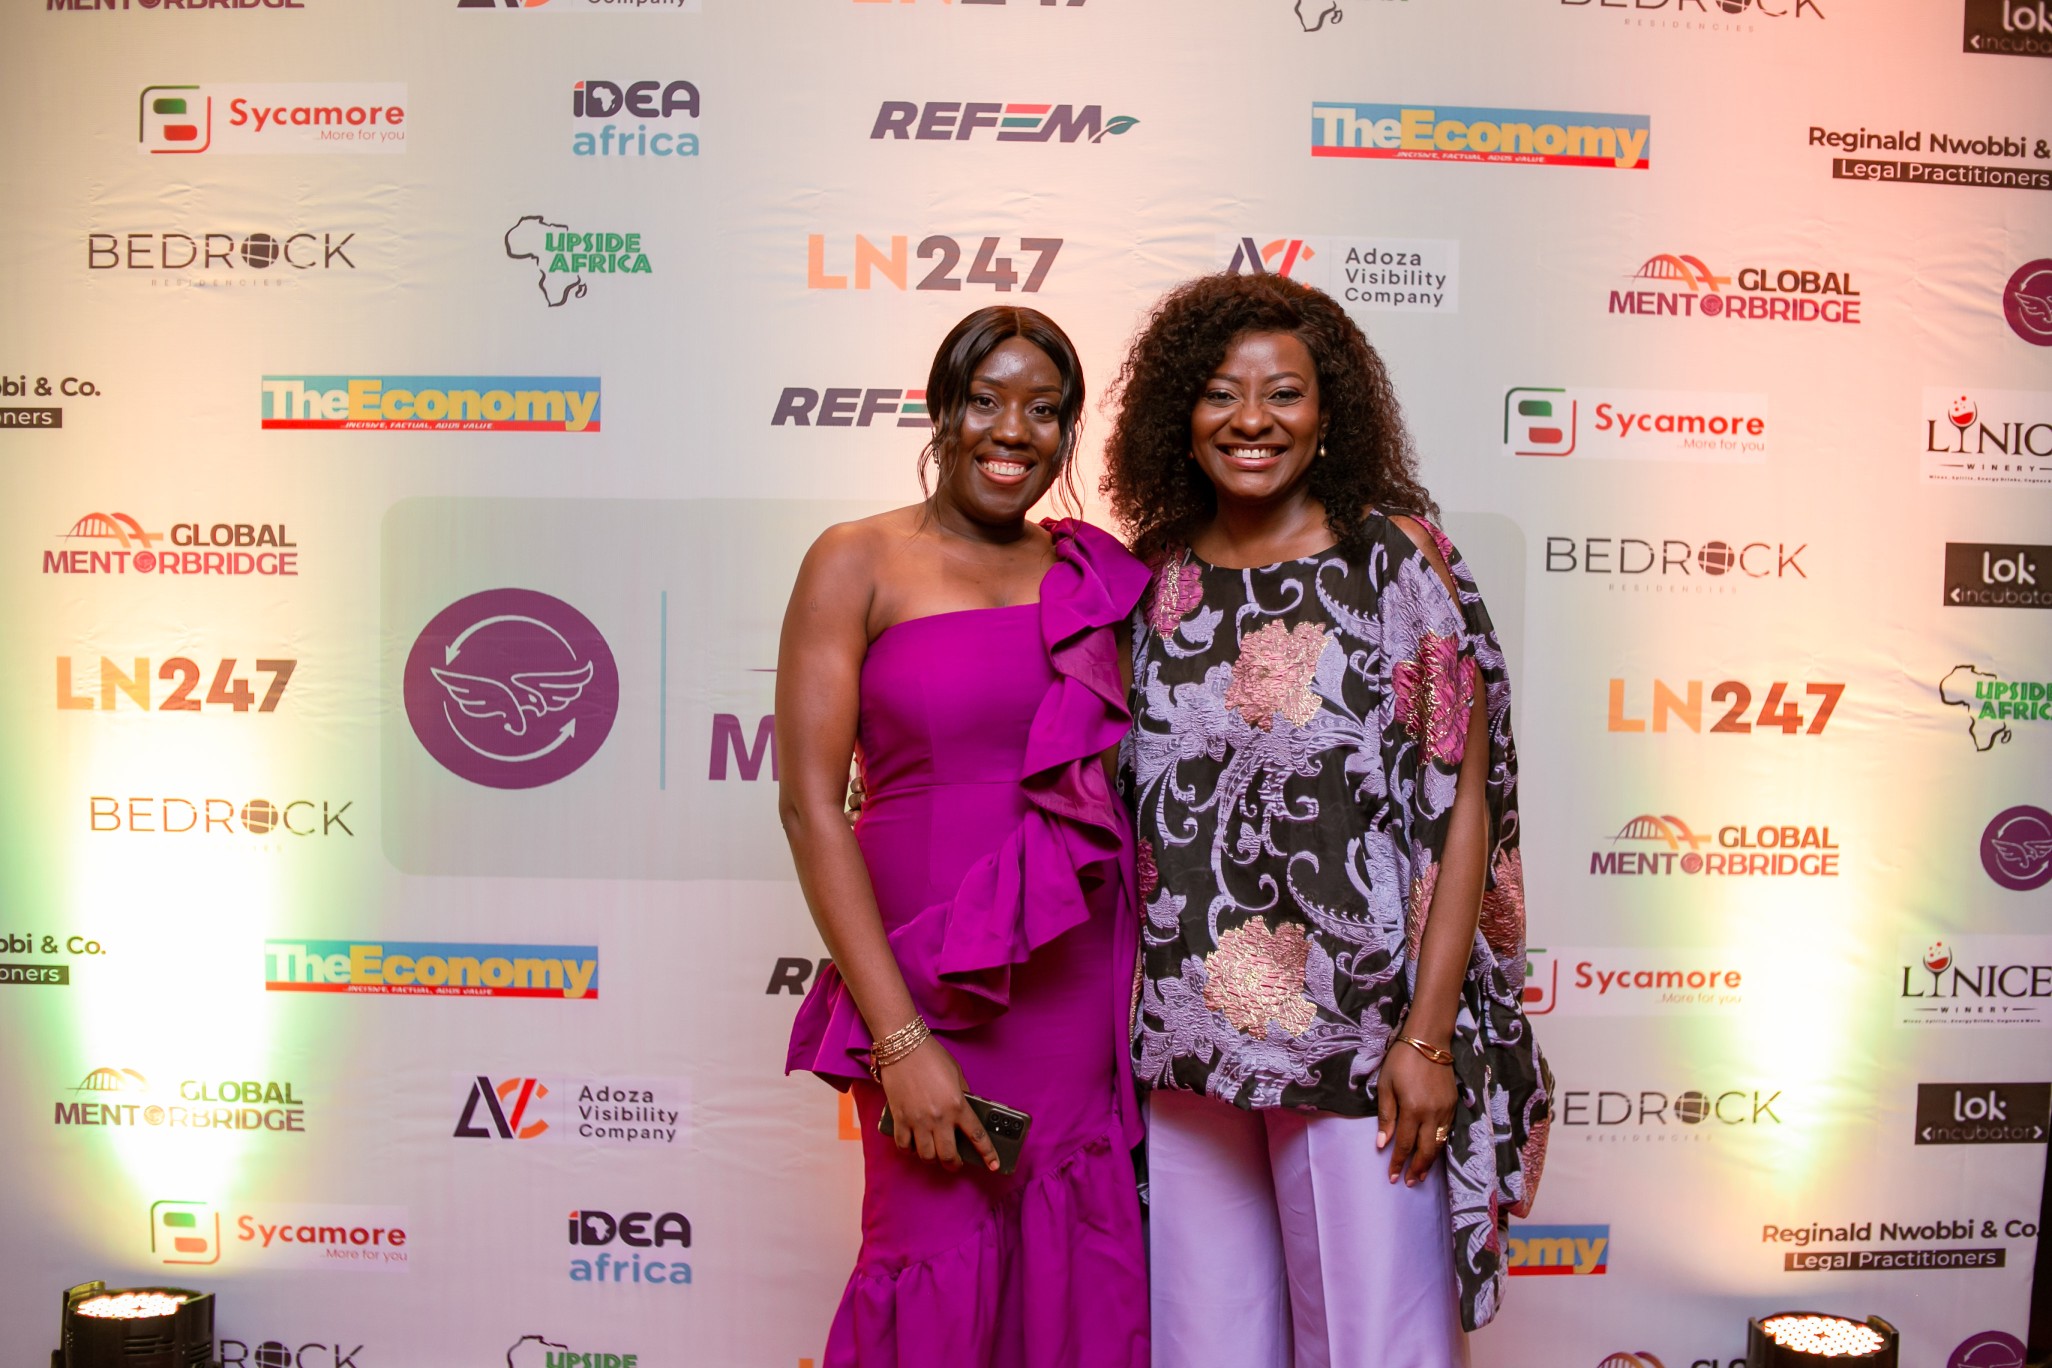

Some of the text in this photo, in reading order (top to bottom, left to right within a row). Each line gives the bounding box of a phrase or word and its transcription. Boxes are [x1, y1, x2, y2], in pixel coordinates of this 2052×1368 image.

[229, 98, 405, 132] Sycamore
[358, 129, 376, 141] for
[380, 131, 405, 142] you
[572, 124, 700, 156] africa
[1809, 127, 2051, 159] Reginald Nwobbi &
[1841, 160, 2050, 187] Legal Practitioners
[88, 233, 356, 269] BEDROCK
[545, 232, 641, 253] UPSIDE
[549, 253, 652, 274] AFRICA
[808, 234, 1063, 292] LN247
[1345, 247, 1422, 266] Adoza
[1345, 268, 1446, 289] Visibility
[1738, 268, 1860, 296] GLOBAL
[1345, 287, 1443, 307] Company
[34, 377, 52, 397] &
[60, 377, 101, 397] Co.
[0, 411, 52, 425] ners
[1595, 403, 1765, 437] Sycamore
[1720, 439, 1737, 449] for
[1741, 442, 1765, 452] you
[1967, 463, 2035, 472] WINERY
[171, 523, 297, 548] GLOBAL
[1546, 537, 1808, 578] BEDROCK
[1983, 551, 2036, 585] lok
[56, 656, 298, 713] LN247
[1608, 678, 1846, 735] LN247
[1978, 701, 2052, 721] AFRIC
[90, 796, 354, 837] BEDROCK
[1719, 826, 1839, 849] GLOBAL
[41, 935, 58, 954] &
[66, 936, 106, 955] Co.
[1575, 962, 1742, 995] Sycamore
[1941, 1006, 2009, 1014] WINERY
[180, 1080, 303, 1105] GLOBAL
[578, 1085, 654, 1103] Adoza
[578, 1104, 679, 1125] Visibility
[1549, 1091, 1783, 1126] EDROCK
[1954, 1090, 2007, 1121] lok
[578, 1123, 677, 1143] Company
[237, 1214, 407, 1248] Sycamore
[1762, 1222, 1872, 1246] Reginald
[1880, 1219, 1974, 1241] Nwobbi
[1981, 1220, 1998, 1239] &
[362, 1250, 379, 1260] for
[383, 1251, 407, 1263] you
[1793, 1249, 1996, 1271] Legal Practitioners
[569, 1254, 692, 1285] africa
